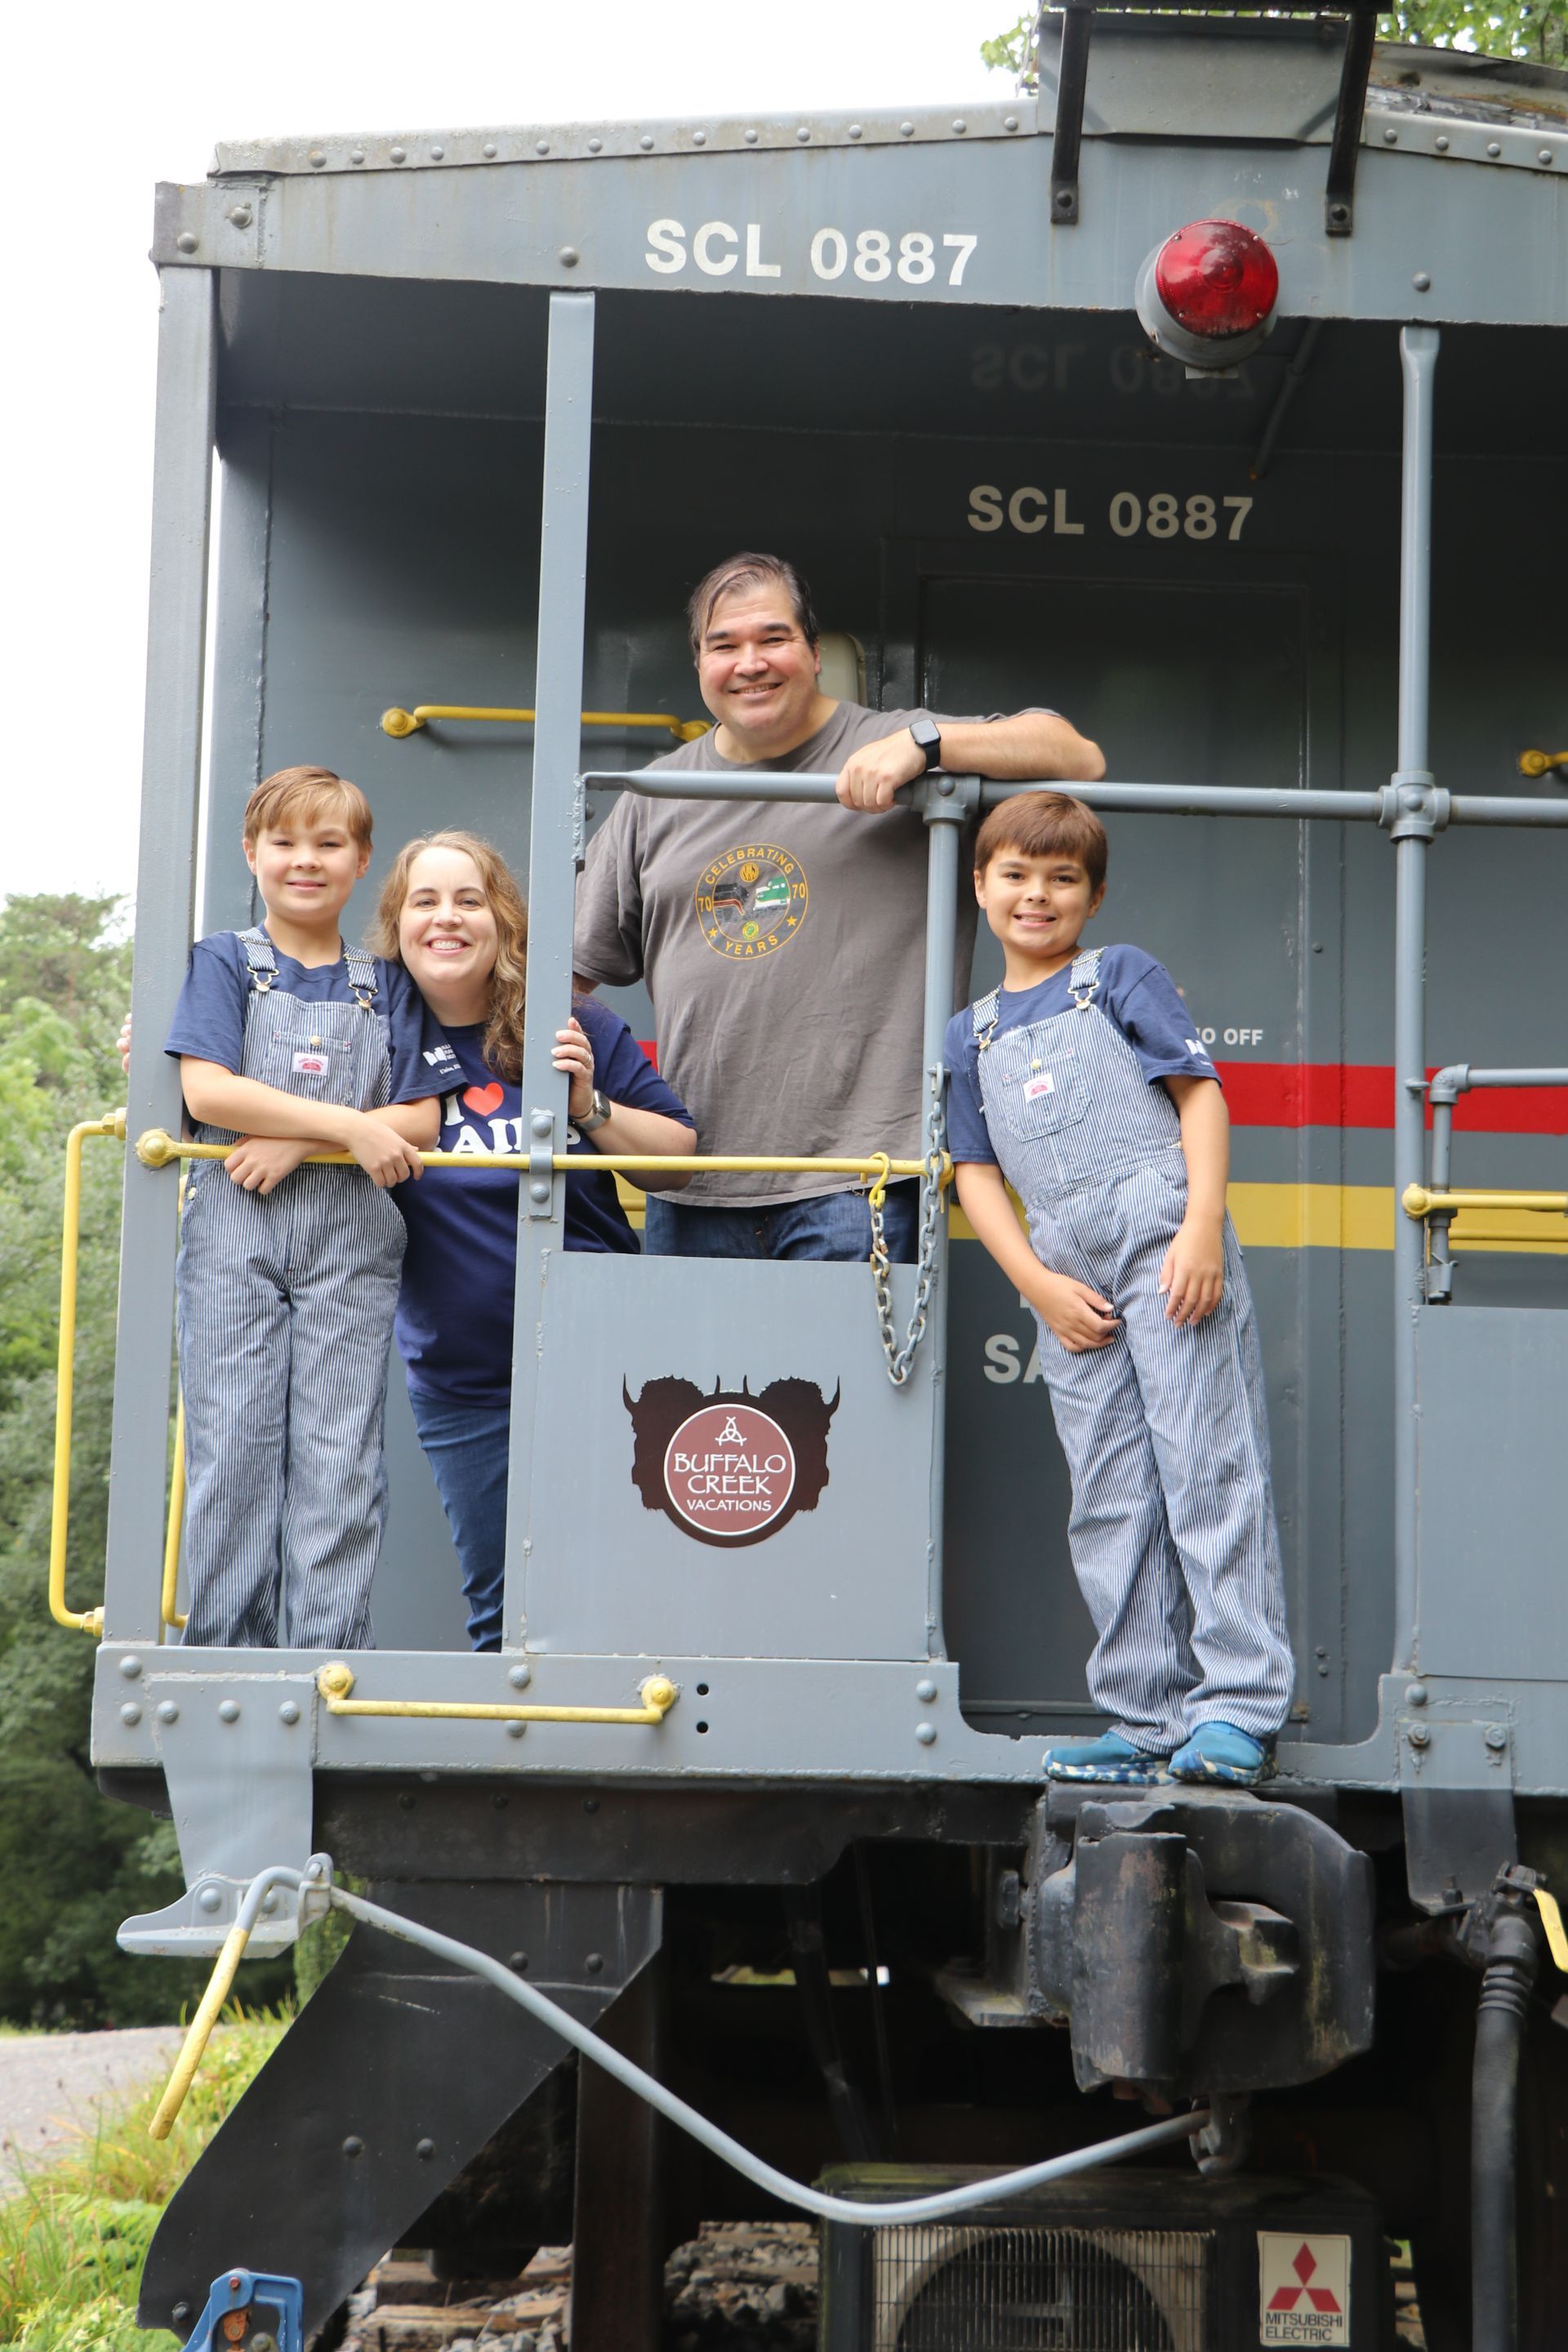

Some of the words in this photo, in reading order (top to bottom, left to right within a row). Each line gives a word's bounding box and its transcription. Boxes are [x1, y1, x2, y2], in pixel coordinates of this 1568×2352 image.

[644, 218, 782, 277] SCL
[810, 227, 978, 286] 0887
[967, 484, 1085, 535] SCL
[1109, 492, 1254, 541] 0887
[705, 848, 795, 885] CELEBRATING
[792, 883, 806, 899] 70
[698, 896, 713, 913] 70
[724, 934, 778, 956] YEARS
[1223, 1028, 1263, 1046] OFF
[674, 1453, 786, 1473] BUFFALO
[687, 1475, 773, 1494] CREEK
[686, 1499, 772, 1512] VACATIONS
[1266, 2312, 1343, 2328] MITSUBISHI
[1265, 2326, 1332, 2341] ELECTRIC
